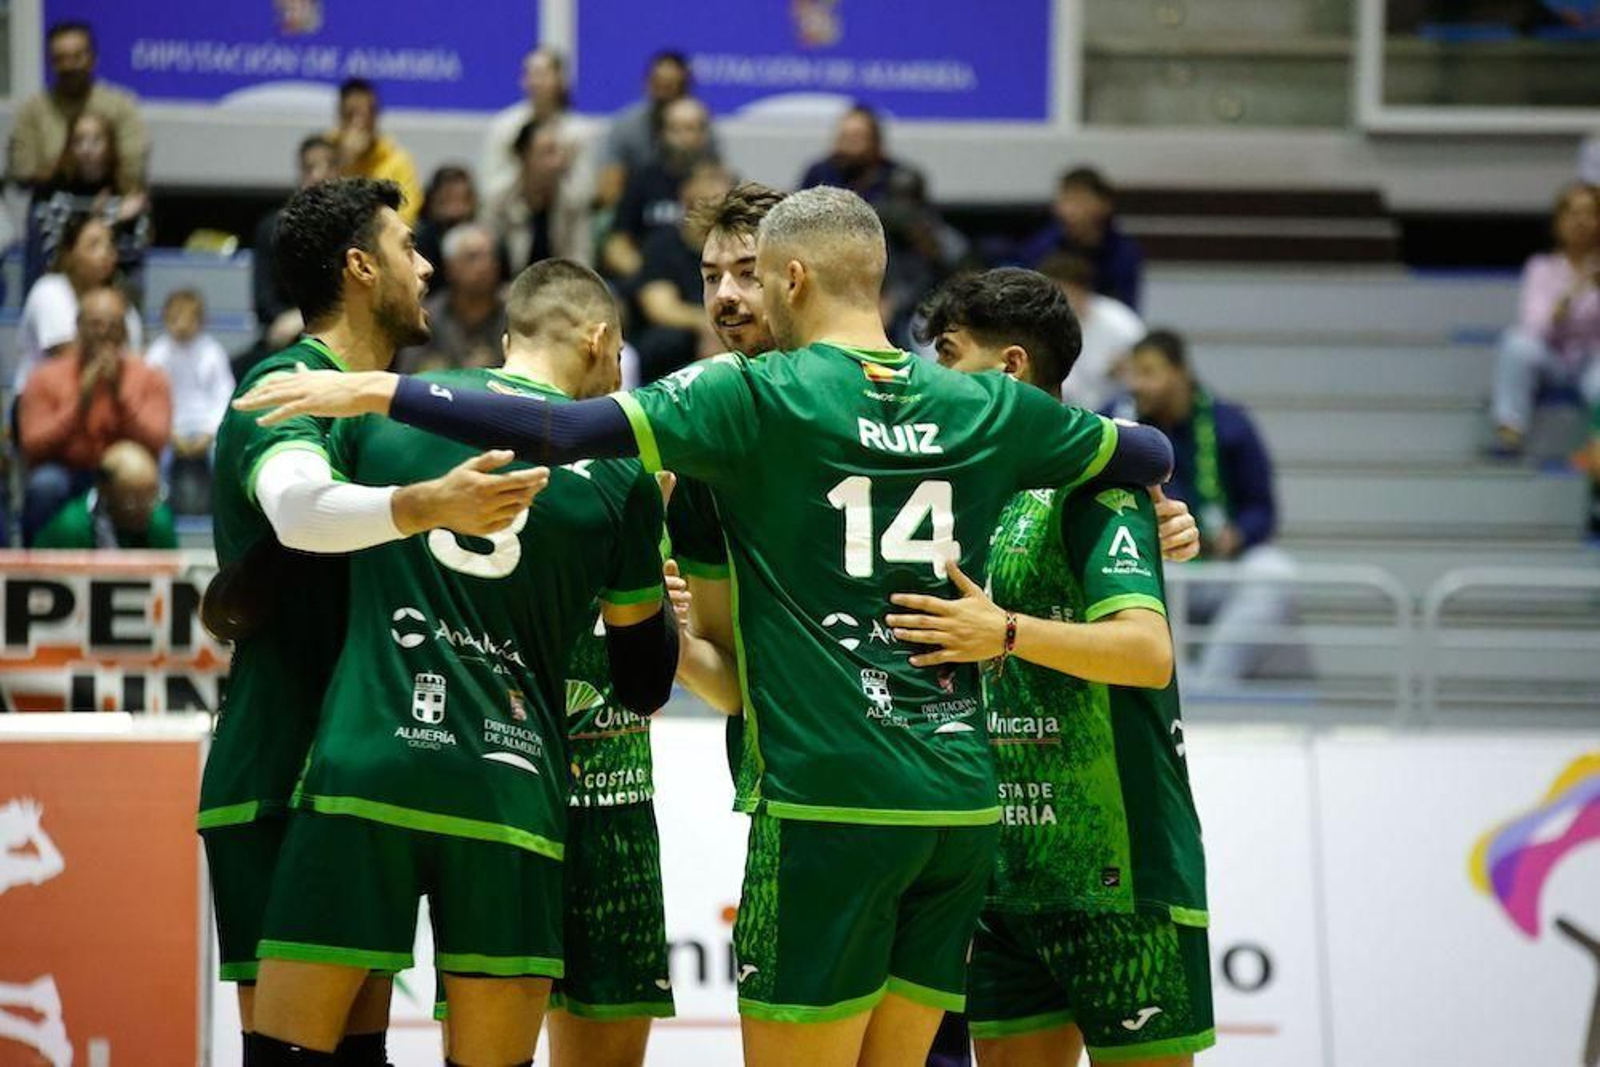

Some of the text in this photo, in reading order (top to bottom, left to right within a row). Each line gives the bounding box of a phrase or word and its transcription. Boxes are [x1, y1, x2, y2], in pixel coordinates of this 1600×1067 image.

[301, 45, 340, 78] DE
[857, 416, 944, 454] RUIZ
[827, 475, 961, 580] 14
[394, 726, 457, 745] ALMERÍA
[484, 718, 543, 746] DIPUTACIÓN
[484, 731, 501, 743] DE
[986, 711, 1060, 738] Unicaja
[584, 768, 635, 789] COSTA
[998, 782, 1053, 798] STA DE
[999, 799, 1057, 825] ERÍA
